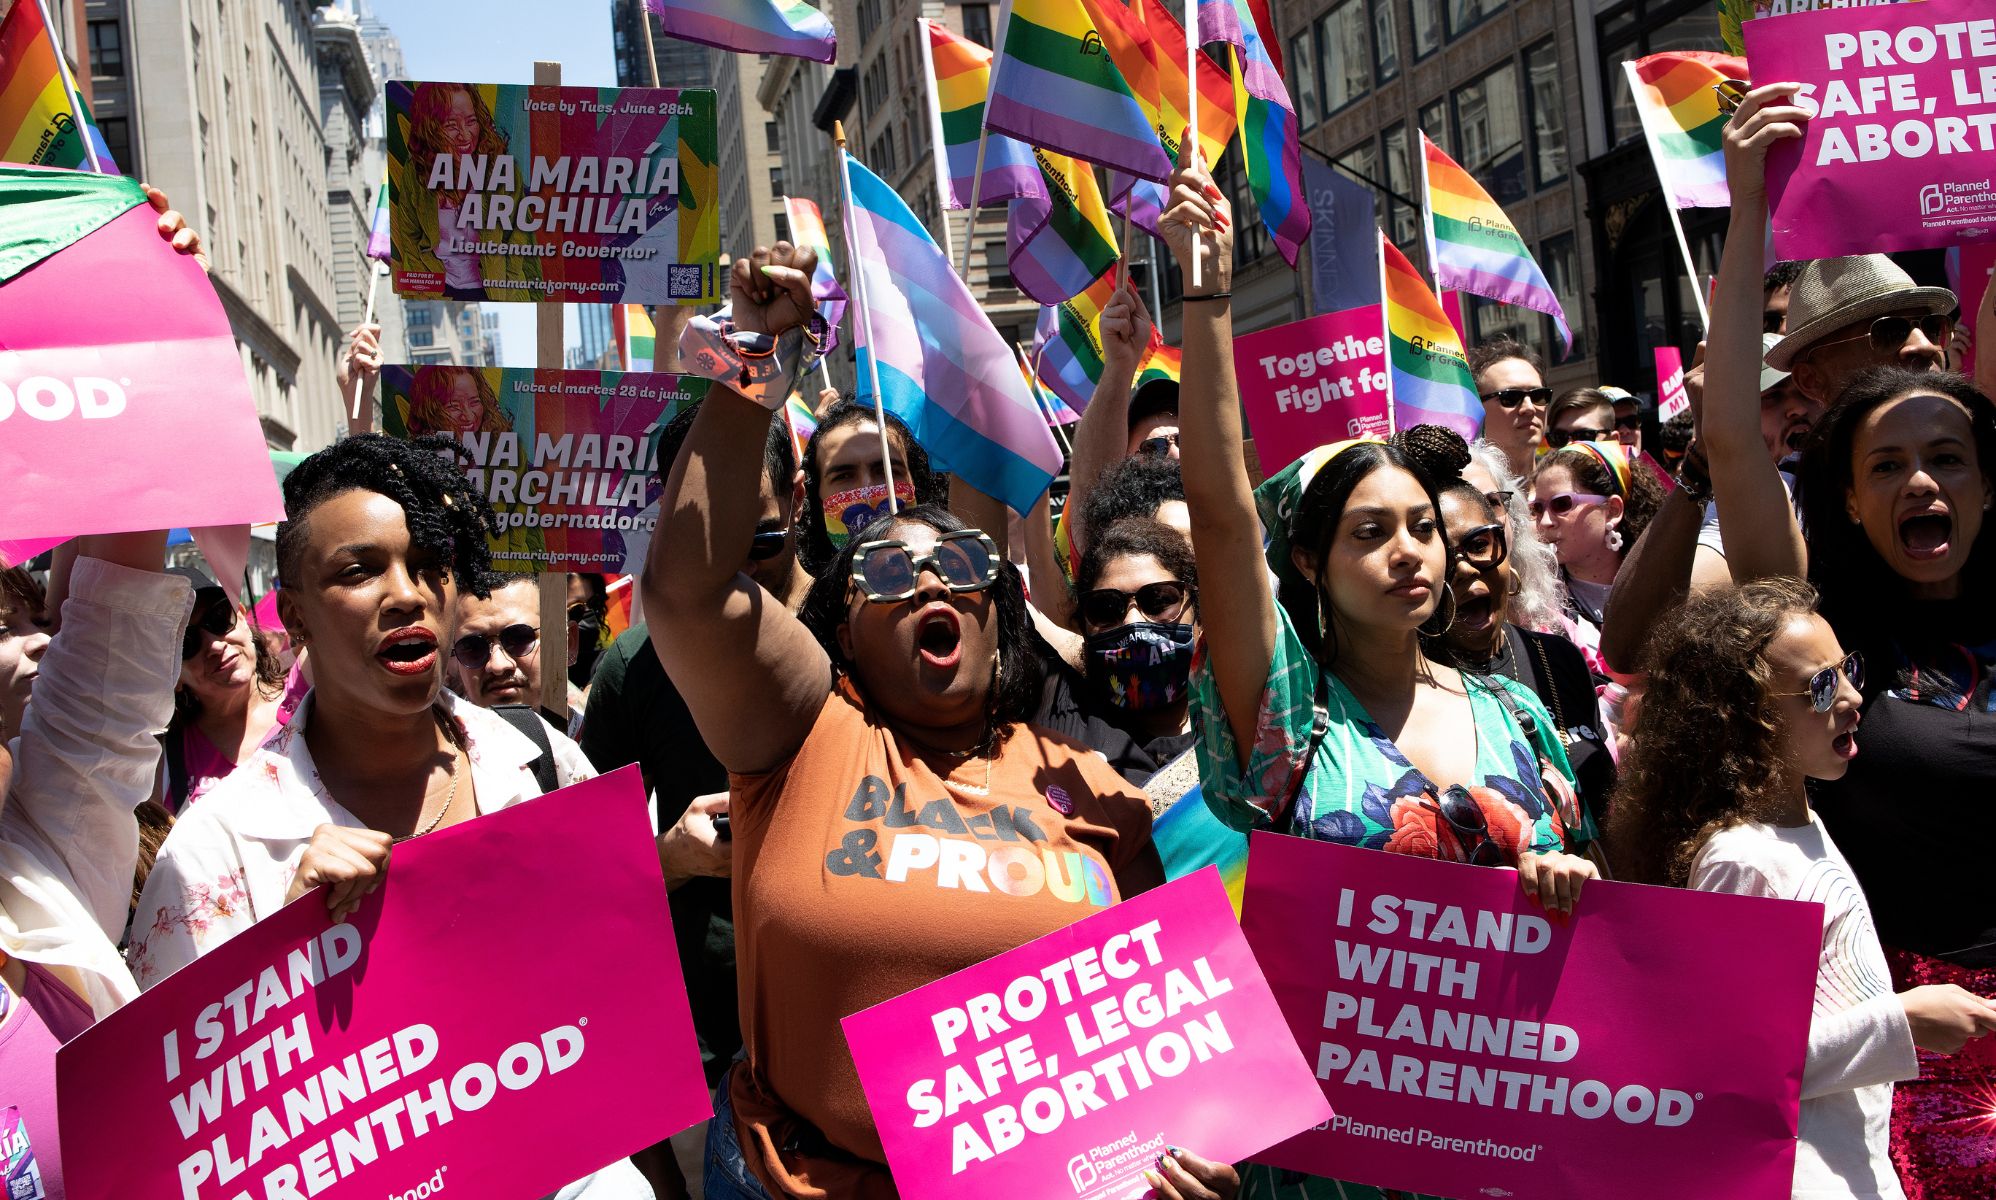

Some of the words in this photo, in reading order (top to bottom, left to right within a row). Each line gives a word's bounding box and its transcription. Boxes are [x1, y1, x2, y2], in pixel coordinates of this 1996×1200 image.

[523, 99, 555, 112] Vote
[559, 99, 576, 116] by
[580, 100, 617, 116] Tues,
[620, 102, 655, 115] June
[658, 102, 693, 116] 28th
[1788, 73, 1937, 120] SAFE,
[427, 153, 516, 192] ANA
[530, 142, 679, 195] MARÍA
[1032, 146, 1079, 203] Parenthood
[1943, 179, 1990, 193] Planned
[456, 194, 647, 234] ARCHILA
[649, 202, 671, 217] for
[450, 236, 557, 258] Lieutenant
[561, 240, 657, 259] Governor
[1314, 189, 1338, 304] SKINNEY
[482, 277, 620, 296] anamariaforny.com
[1425, 353, 1436, 362] of
[0, 376, 127, 422] OD
[513, 381, 546, 393] Vota
[549, 381, 562, 393] el
[565, 384, 616, 397] martes
[620, 386, 637, 397] 28
[639, 386, 656, 398] de
[657, 388, 692, 402] junio
[1275, 379, 1355, 414] Fight
[1669, 394, 1685, 413] MY
[1360, 413, 1383, 423] Planned
[490, 548, 621, 566] namariaforny.com
[1129, 631, 1148, 642] ARE
[843, 774, 1048, 842] BLACK
[825, 828, 883, 880] &
[885, 833, 1113, 907] PROUD
[1336, 888, 1355, 927] I
[1366, 894, 1552, 954] STAND
[931, 919, 1163, 1057] PROTECT
[1334, 939, 1480, 1000] WITH
[163, 1029, 180, 1083] I
[194, 922, 362, 1060] STAND
[906, 1034, 1059, 1128] SAFE,
[1064, 956, 1233, 1058] LEGAL
[1323, 991, 1580, 1064] PLANNED
[169, 1012, 314, 1141] WITH
[952, 1010, 1235, 1175] ABORTION
[178, 1023, 440, 1200] PLANNED
[1332, 1115, 1415, 1145] Planned
[1089, 1130, 1138, 1161] Planned
[1114, 1168, 1124, 1177] No
